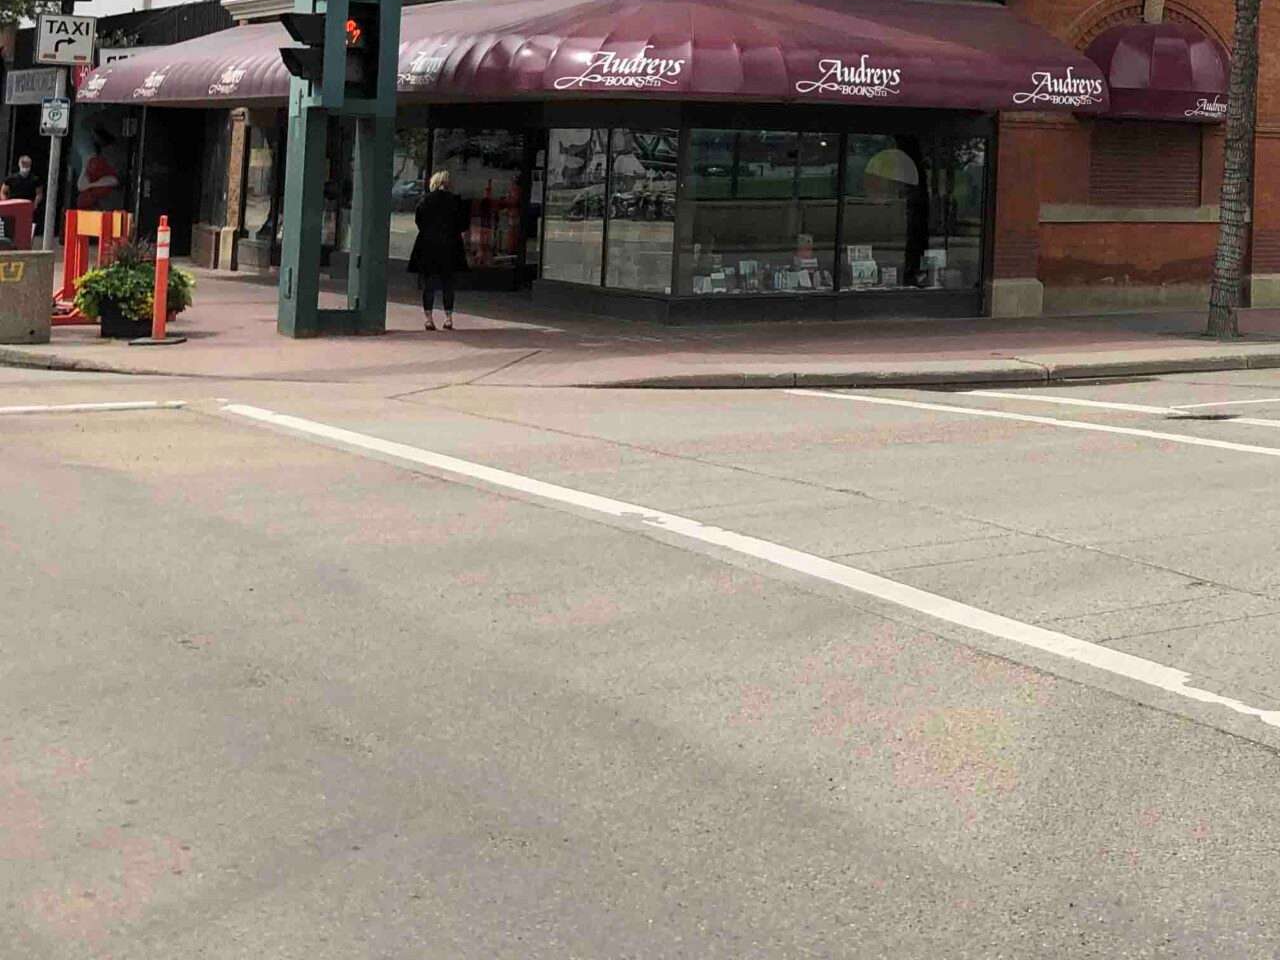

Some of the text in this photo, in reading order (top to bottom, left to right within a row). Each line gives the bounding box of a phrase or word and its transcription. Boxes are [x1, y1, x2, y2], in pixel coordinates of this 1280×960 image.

[46, 20, 90, 36] TAXI
[562, 45, 685, 86] Audreys
[803, 54, 901, 91] Audreys
[604, 76, 645, 88] BOOKS
[1019, 66, 1102, 101] Audreys
[841, 85, 874, 98] BOOKS
[1051, 95, 1080, 107] BOOKS
